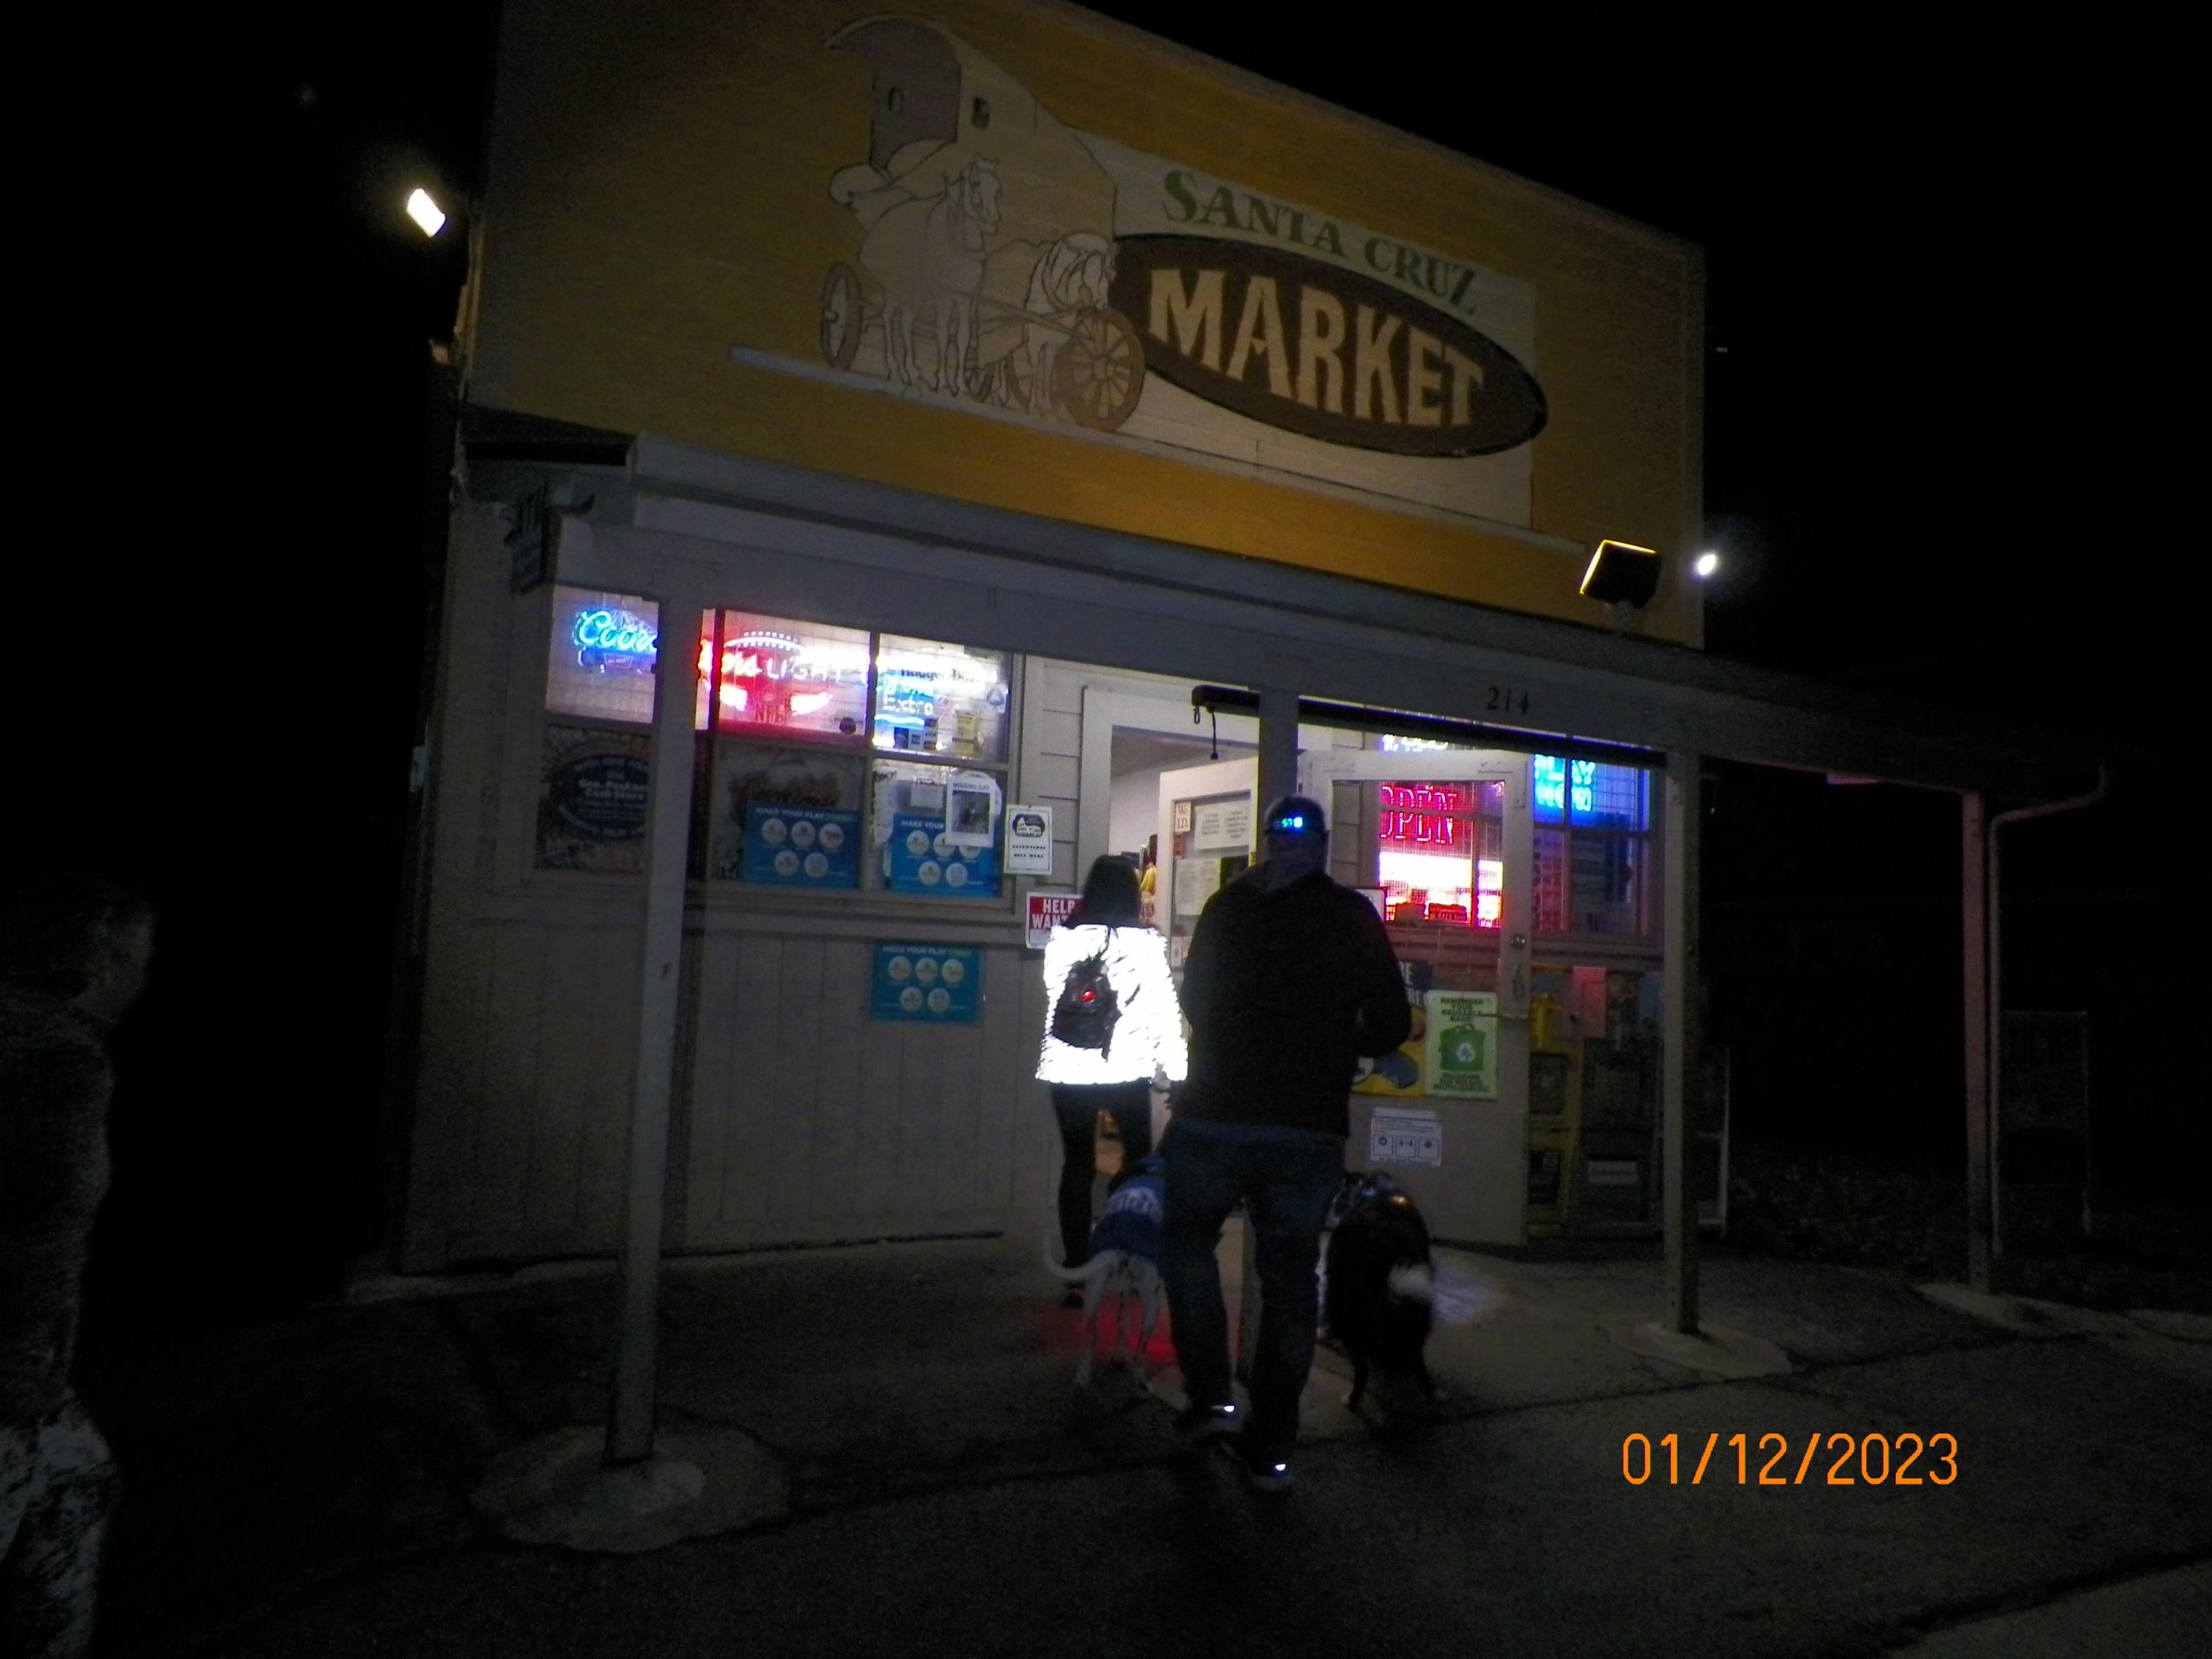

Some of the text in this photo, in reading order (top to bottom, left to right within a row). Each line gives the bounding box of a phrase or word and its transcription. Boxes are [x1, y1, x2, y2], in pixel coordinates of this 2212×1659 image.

[1162, 169, 1477, 315] SANTA CRUZ
[1147, 268, 1484, 427] MARKET
[1486, 685, 1530, 715] 214
[953, 781, 976, 790] MISSING
[755, 806, 779, 816] MAKE
[781, 809, 804, 817] YOUR
[900, 819, 944, 830] MAKE YOUR
[1042, 898, 1076, 915] HELP
[1031, 913, 1070, 930] WANT
[906, 946, 926, 955] YOUR
